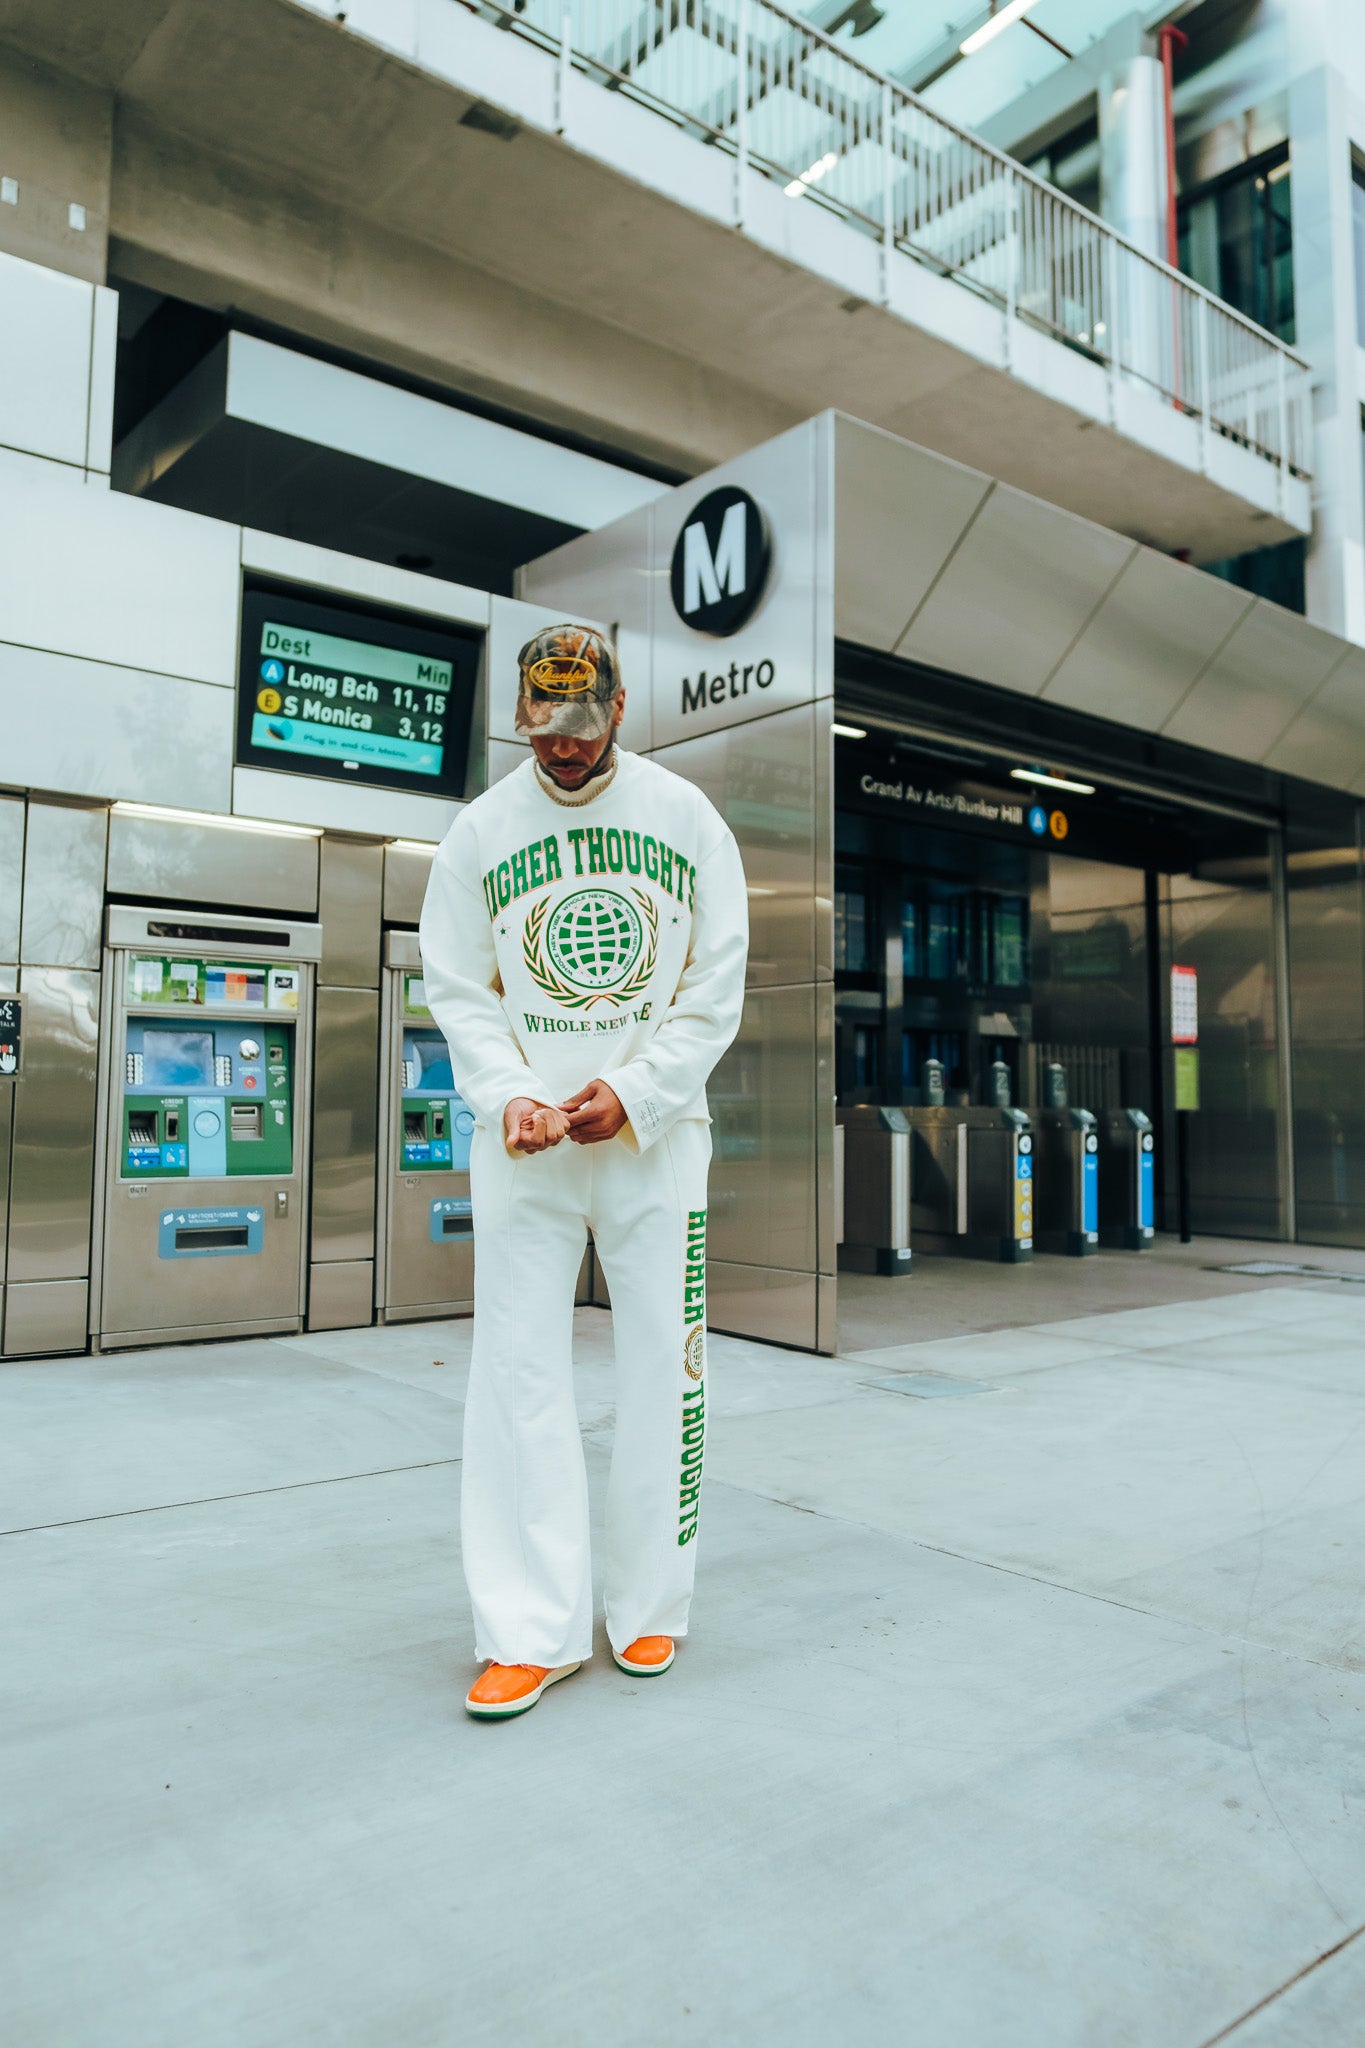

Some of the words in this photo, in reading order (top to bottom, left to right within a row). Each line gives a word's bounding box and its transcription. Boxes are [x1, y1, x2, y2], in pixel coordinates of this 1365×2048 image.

[684, 501, 747, 614] M
[265, 630, 311, 657] Dest
[416, 663, 449, 687] Min
[287, 665, 339, 698] Long
[341, 675, 379, 703] Bch
[392, 687, 419, 713] 11,
[424, 693, 447, 716] 15
[681, 659, 774, 714] Metro
[283, 695, 299, 717] S
[302, 700, 373, 731] Monica
[398, 717, 416, 741] 3,
[420, 721, 444, 743] 12
[860, 774, 902, 799] Grand
[906, 785, 923, 803] Av
[925, 790, 999, 821] Arts/Bunker
[1001, 805, 1024, 825] Hill
[552, 914, 561, 930] VIBE
[562, 895, 586, 911] WHOLE
[608, 896, 623, 906] VIBE
[625, 907, 638, 932] WHOLE
[550, 933, 558, 951] NEW
[554, 952, 574, 976] WHOLE
[523, 1012, 591, 1033] WHOLE
[595, 1013, 630, 1031] NEW
[632, 1001, 653, 1025] VE
[684, 1209, 707, 1325] HIGHER
[677, 1380, 705, 1547] THOUGHTS
